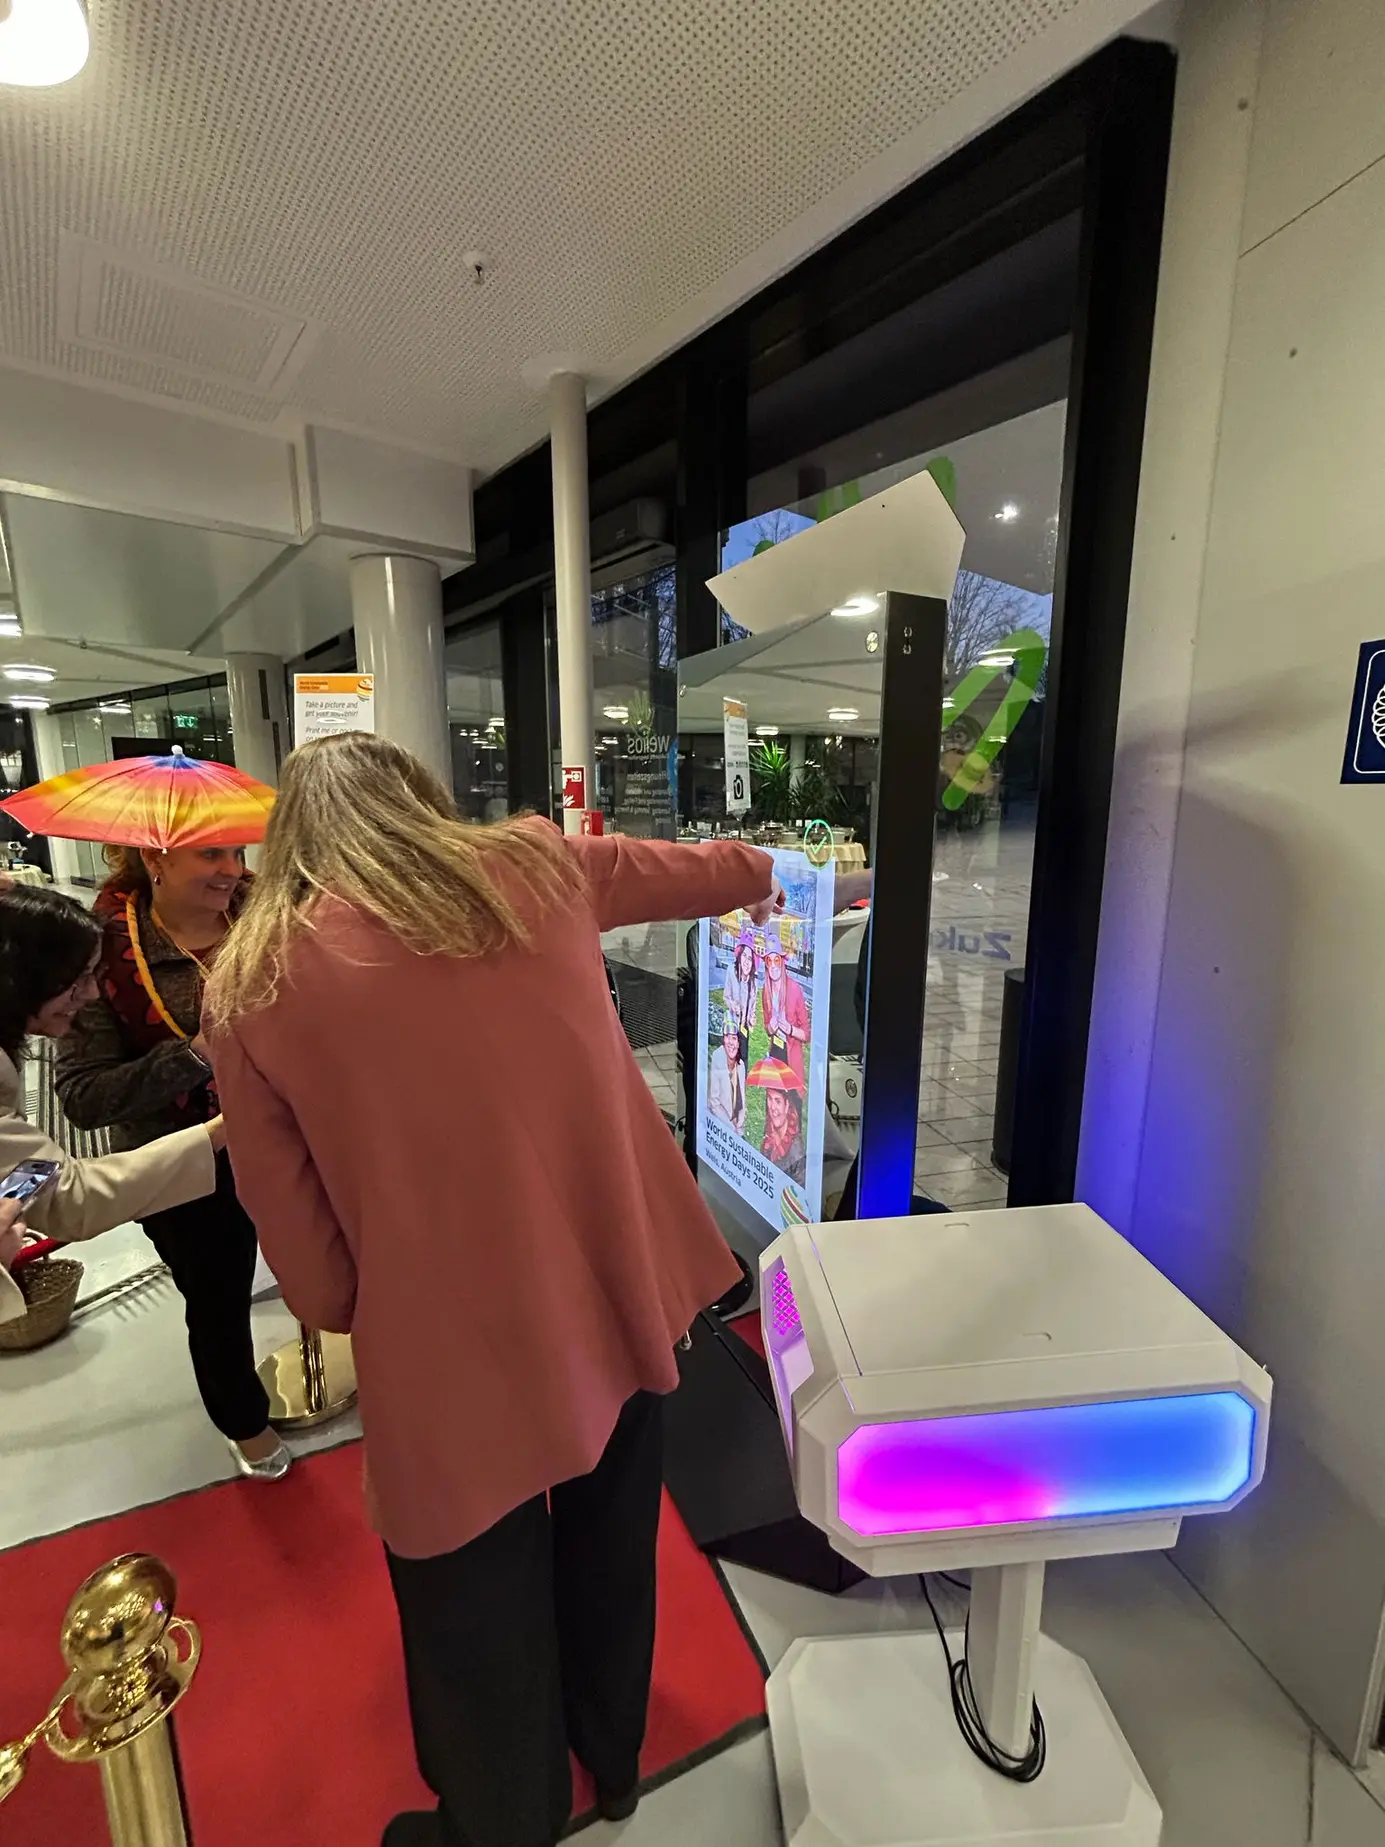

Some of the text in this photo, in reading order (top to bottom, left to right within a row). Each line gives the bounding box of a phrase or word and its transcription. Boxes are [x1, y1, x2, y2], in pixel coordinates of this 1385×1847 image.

[305, 710, 315, 718] get
[324, 701, 346, 710] picture
[706, 1117, 774, 1184] World Sustainable
[706, 1131, 774, 1200] Energy Days 2025
[720, 1163, 742, 1187] Austria
